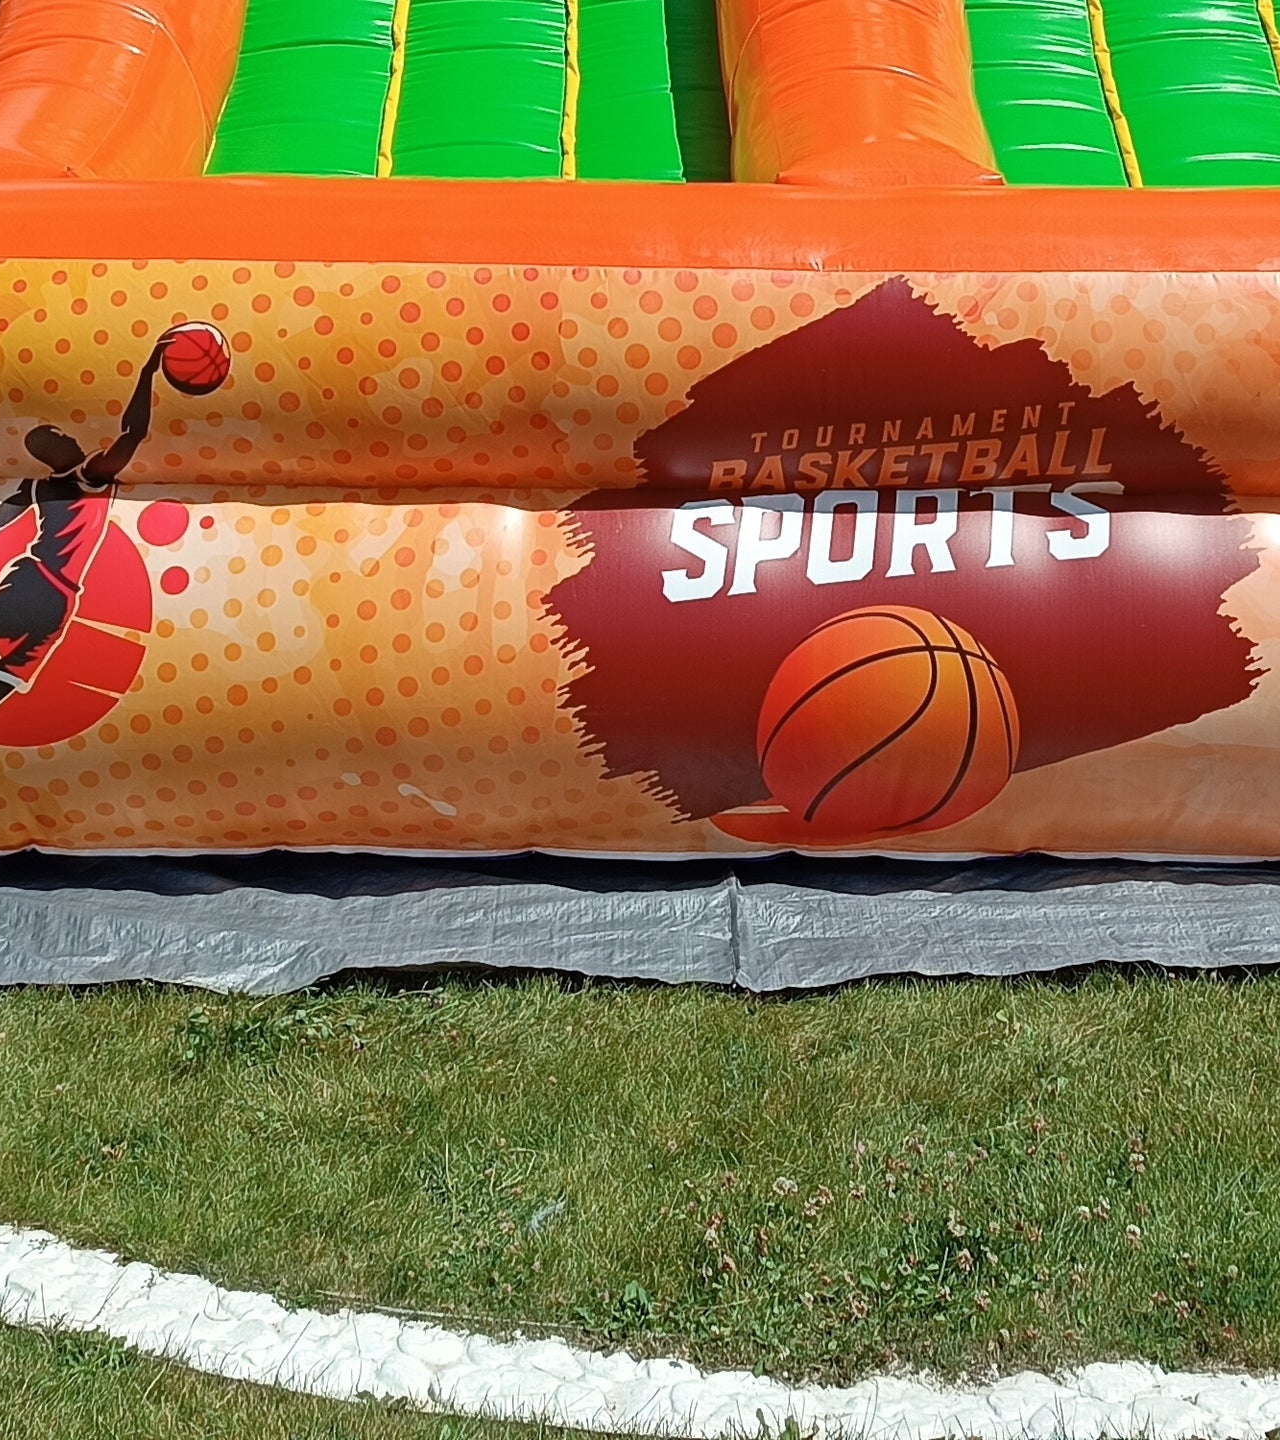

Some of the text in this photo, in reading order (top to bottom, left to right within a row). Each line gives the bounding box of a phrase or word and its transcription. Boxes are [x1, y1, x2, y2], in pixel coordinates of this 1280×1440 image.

[710, 426, 1113, 492] BASKETBALL
[750, 401, 1076, 453] TOURNAMENT
[661, 481, 1125, 603] SPORTS
